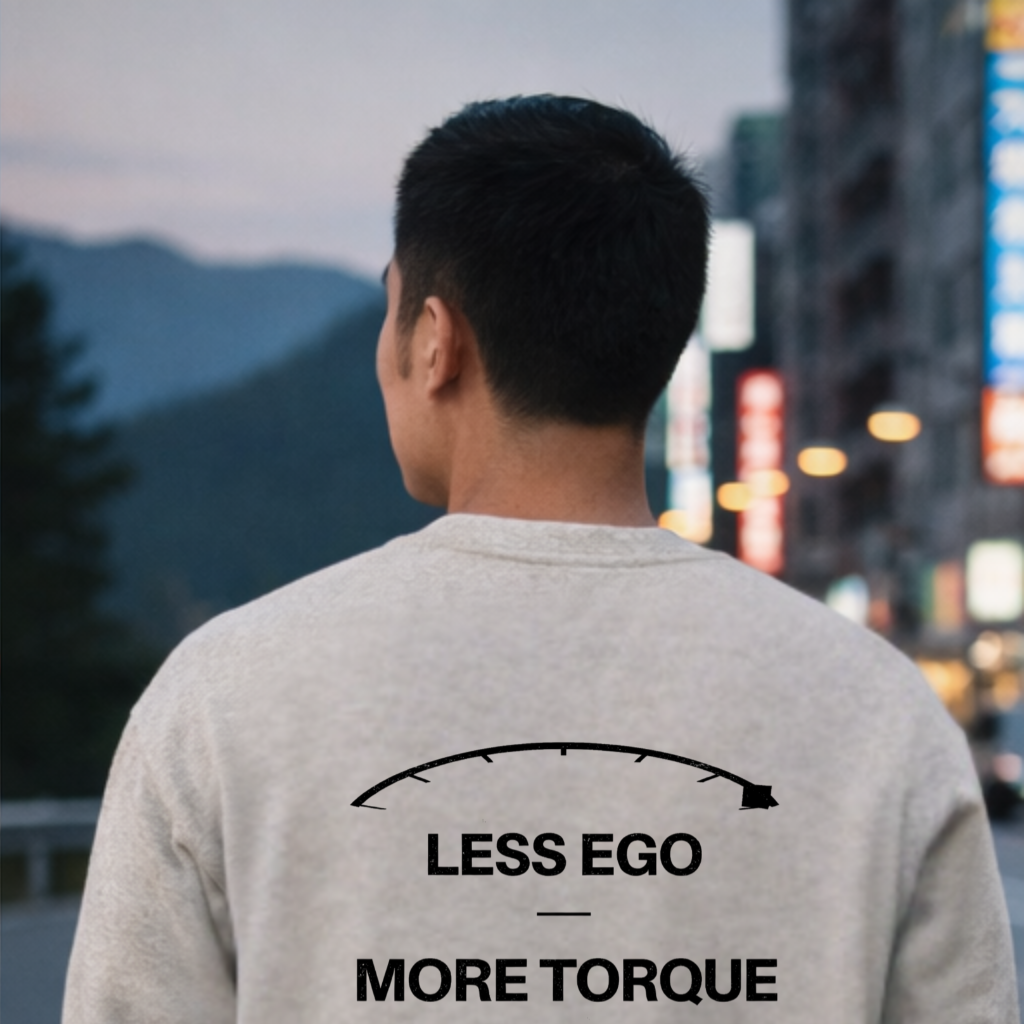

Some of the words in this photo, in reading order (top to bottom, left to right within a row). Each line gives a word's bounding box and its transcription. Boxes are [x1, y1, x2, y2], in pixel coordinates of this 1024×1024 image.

[428, 833, 566, 876] LESS
[582, 833, 702, 876] EGO
[357, 958, 528, 1002] MORE
[540, 958, 778, 1005] TORQUE
